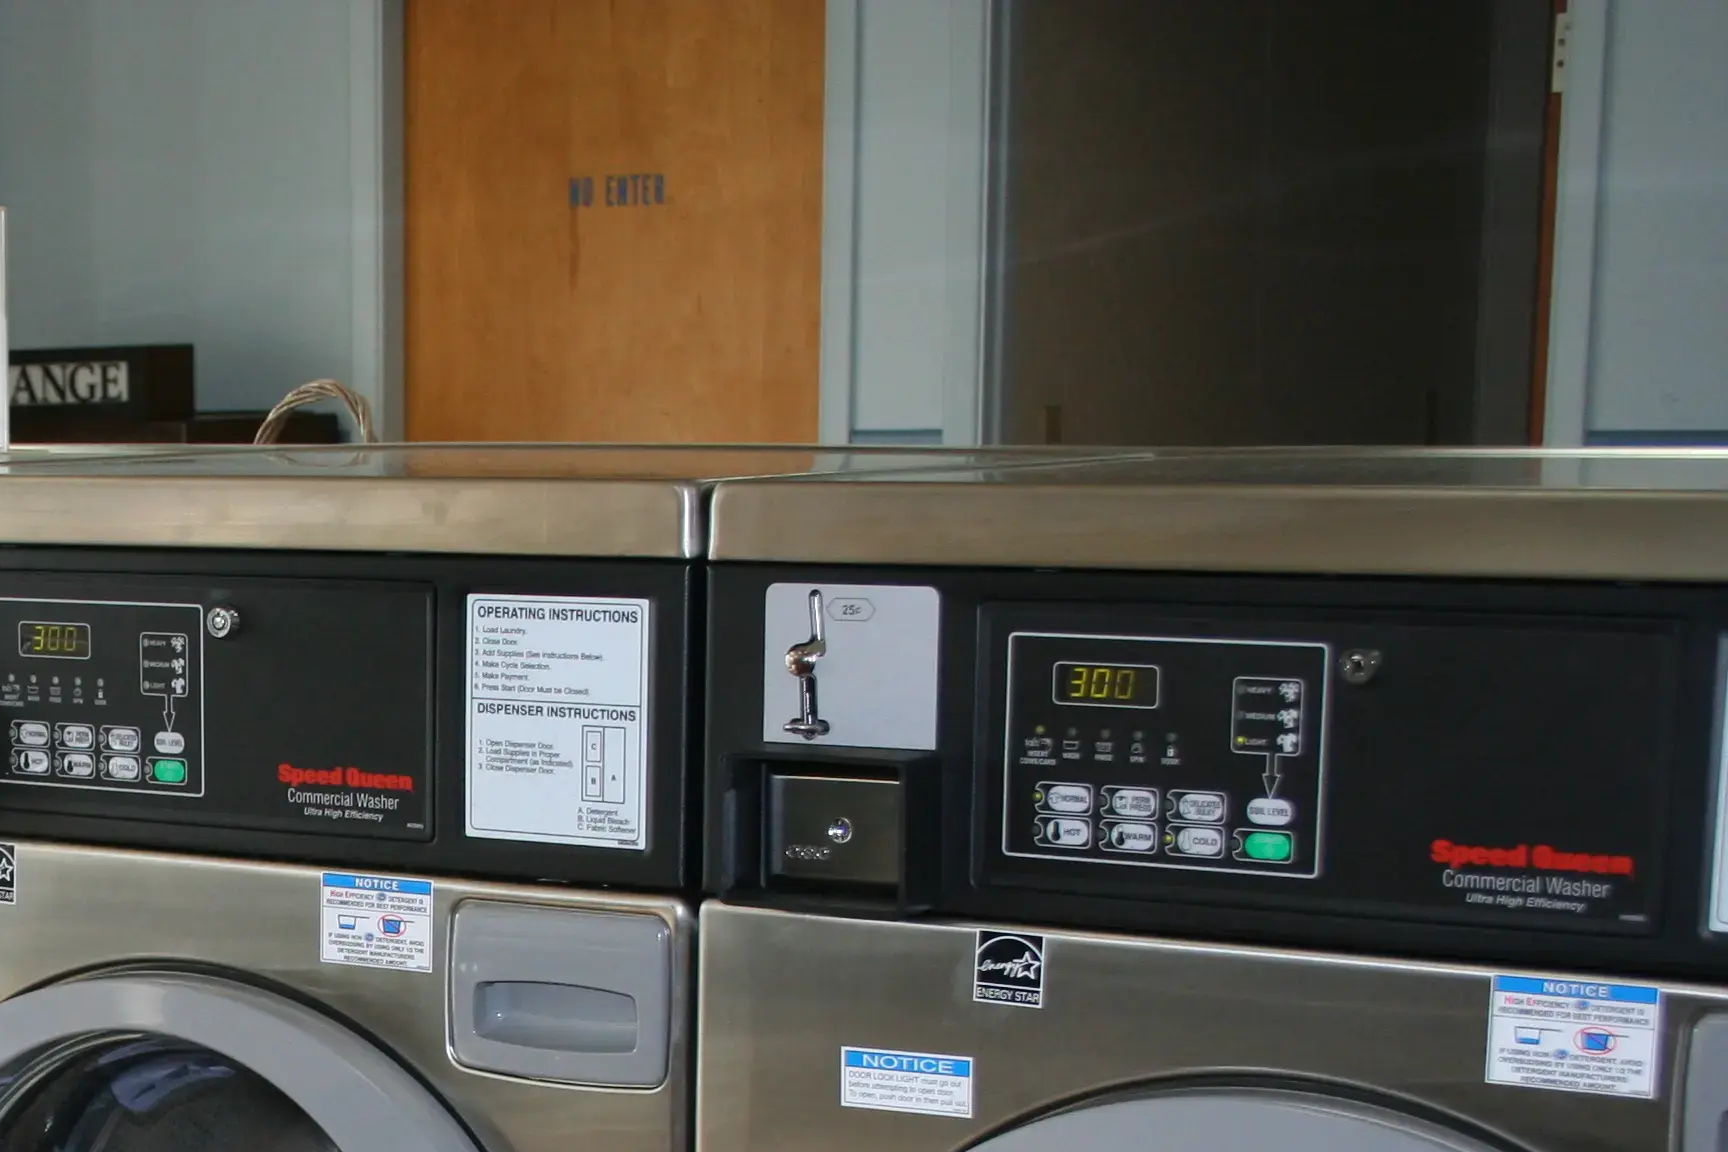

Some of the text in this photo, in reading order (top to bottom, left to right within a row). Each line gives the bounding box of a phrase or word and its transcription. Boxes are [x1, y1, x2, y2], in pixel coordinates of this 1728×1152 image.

[569, 174, 665, 208] NO ENTER
[11, 363, 122, 403] ANGE
[478, 606, 638, 623] OPERATING INSTRUCTIONS
[33, 626, 77, 651] 300
[1070, 668, 1135, 699] 300
[478, 703, 636, 721] DISPENSER INSTRUCTIONS
[278, 763, 413, 790] Speed Queen
[288, 788, 399, 810] Commercial Washer
[304, 807, 384, 823] Ultra High Efficiency
[586, 808, 618, 818] Detergent
[1063, 827, 1082, 837] HOT
[1124, 832, 1152, 841] WARM
[1192, 837, 1218, 846] COLD
[1431, 839, 1634, 875] Speed Queen
[355, 878, 400, 890] NOTICE
[1442, 869, 1612, 899] Commercial Washer
[1465, 893, 1586, 913] Ultra High Efficiency
[977, 986, 1040, 1003] ENERGY STAR
[1543, 982, 1609, 998] NOTICE
[1556, 1010, 1571, 1019] FOR
[1573, 1011, 1592, 1021] BEST
[862, 1054, 954, 1074] NOTICE
[849, 1070, 871, 1080] DOOR
[873, 1072, 895, 1082] LOCK
[896, 1075, 920, 1084] LIGHT
